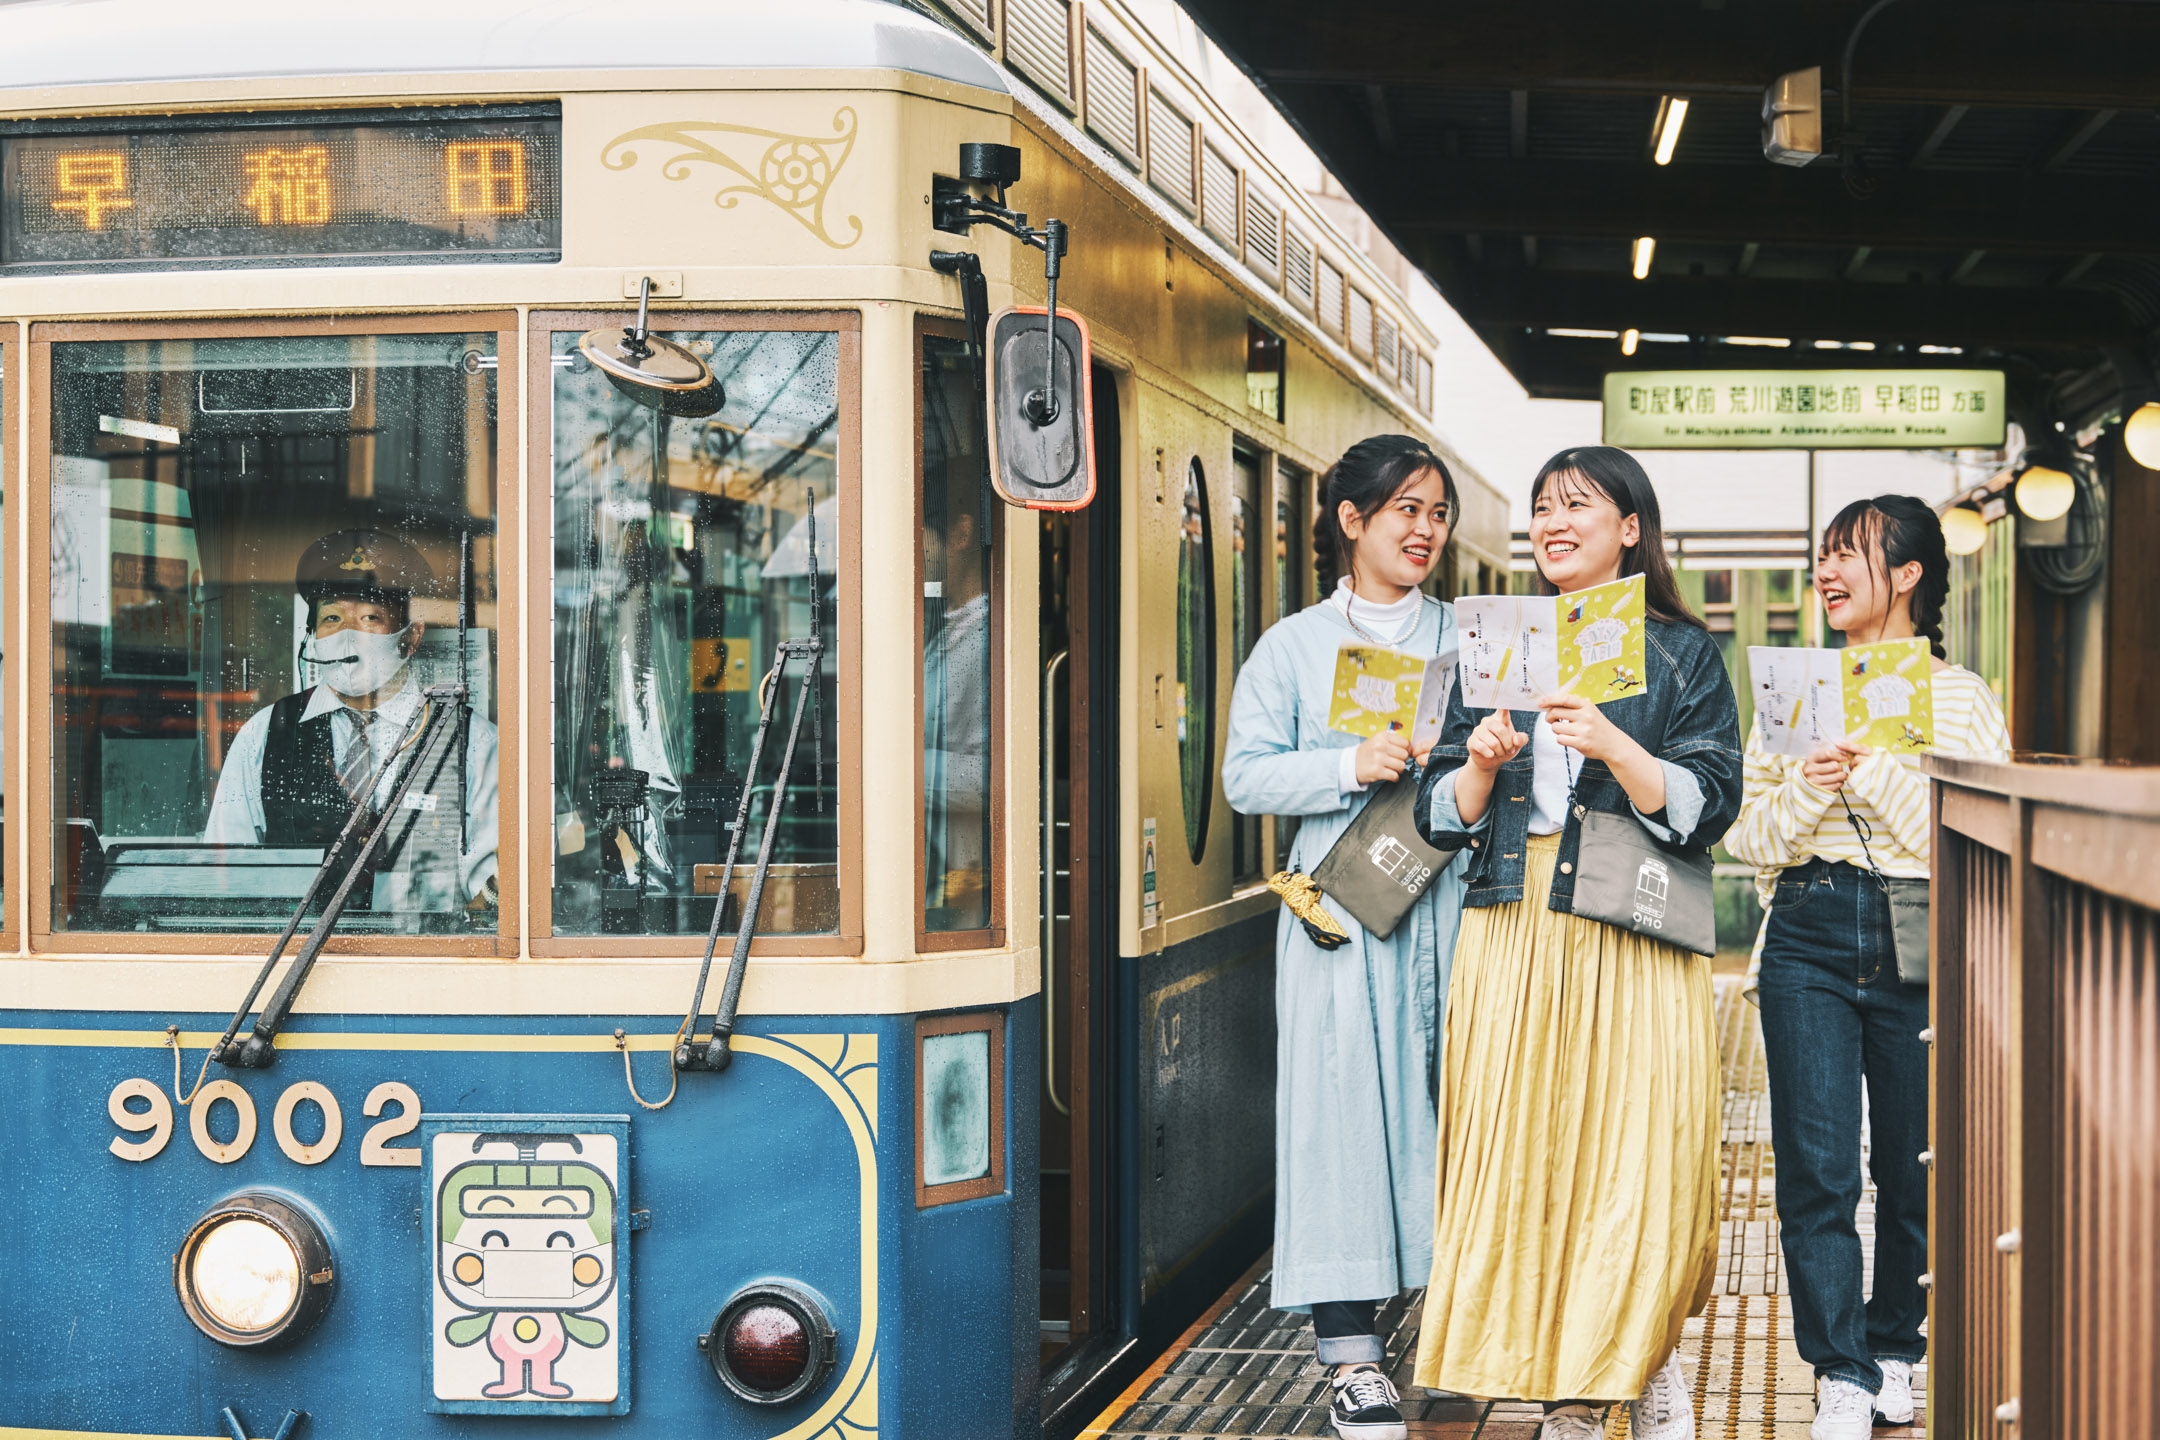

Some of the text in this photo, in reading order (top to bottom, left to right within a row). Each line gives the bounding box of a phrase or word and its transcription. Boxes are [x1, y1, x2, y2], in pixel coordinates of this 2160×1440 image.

[51, 141, 526, 231] 早稲田
[1630, 385, 1986, 415] 町屋駅前 荒川遊園地前 早稲田 方面
[1664, 426, 1680, 436] for
[1904, 425, 1947, 436] Waseda
[1407, 867, 1431, 894] OMO
[1632, 911, 1663, 930] OMO
[108, 1078, 422, 1167] 9002
